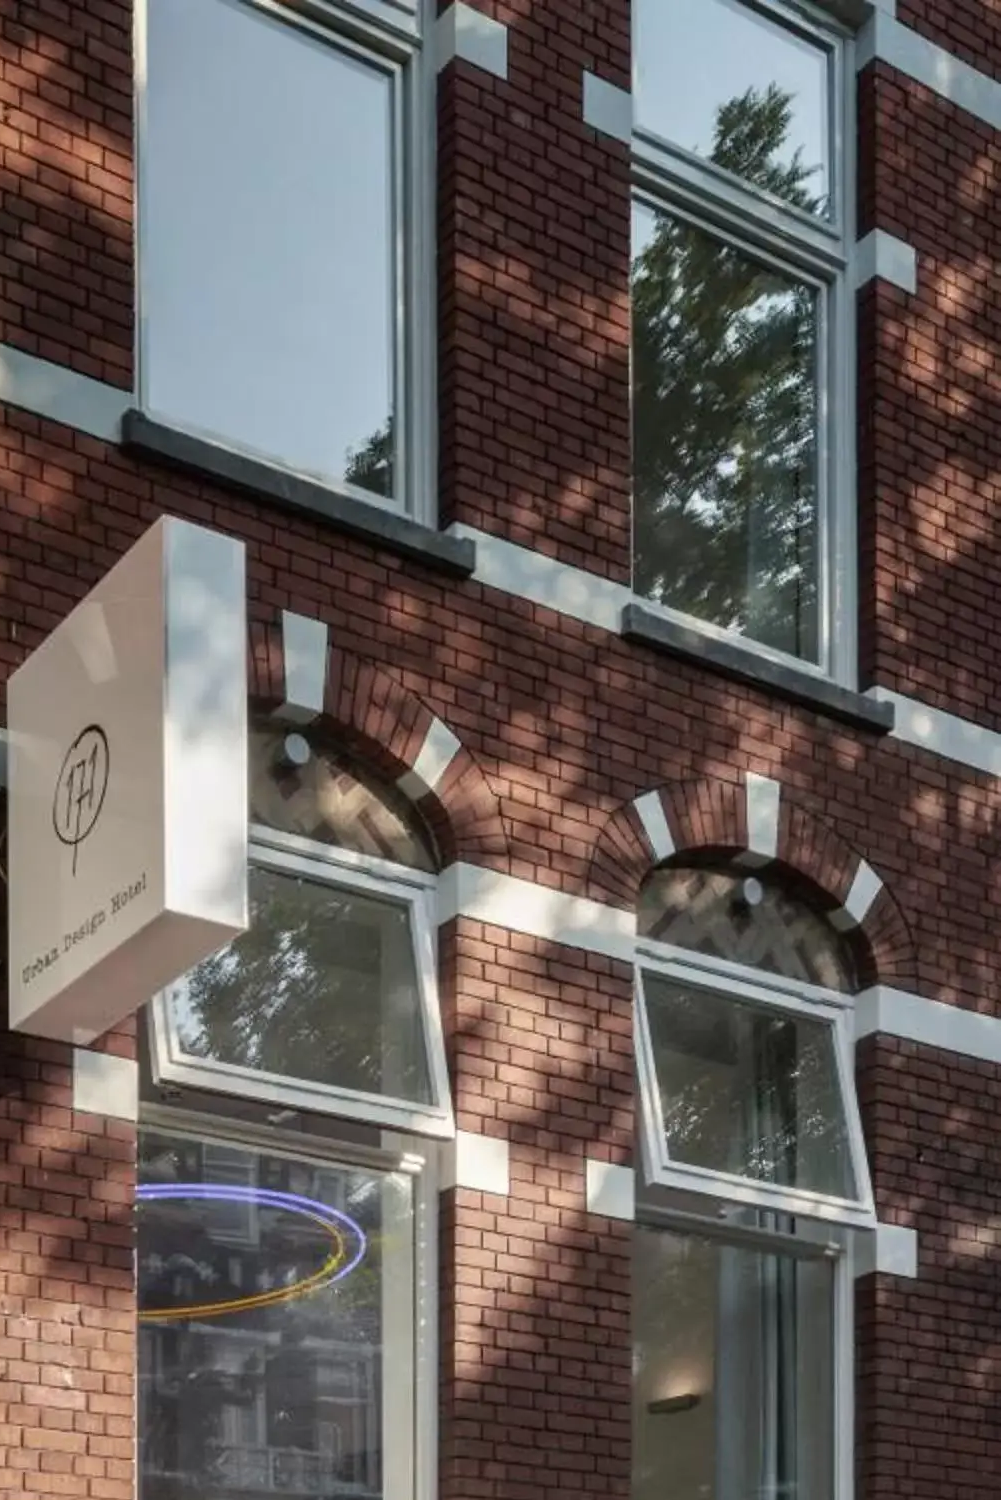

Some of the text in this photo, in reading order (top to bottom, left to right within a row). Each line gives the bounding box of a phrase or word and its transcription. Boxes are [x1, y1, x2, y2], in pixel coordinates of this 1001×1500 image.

[64, 741, 100, 876] 171
[22, 871, 147, 984] Urban Design Hotel
